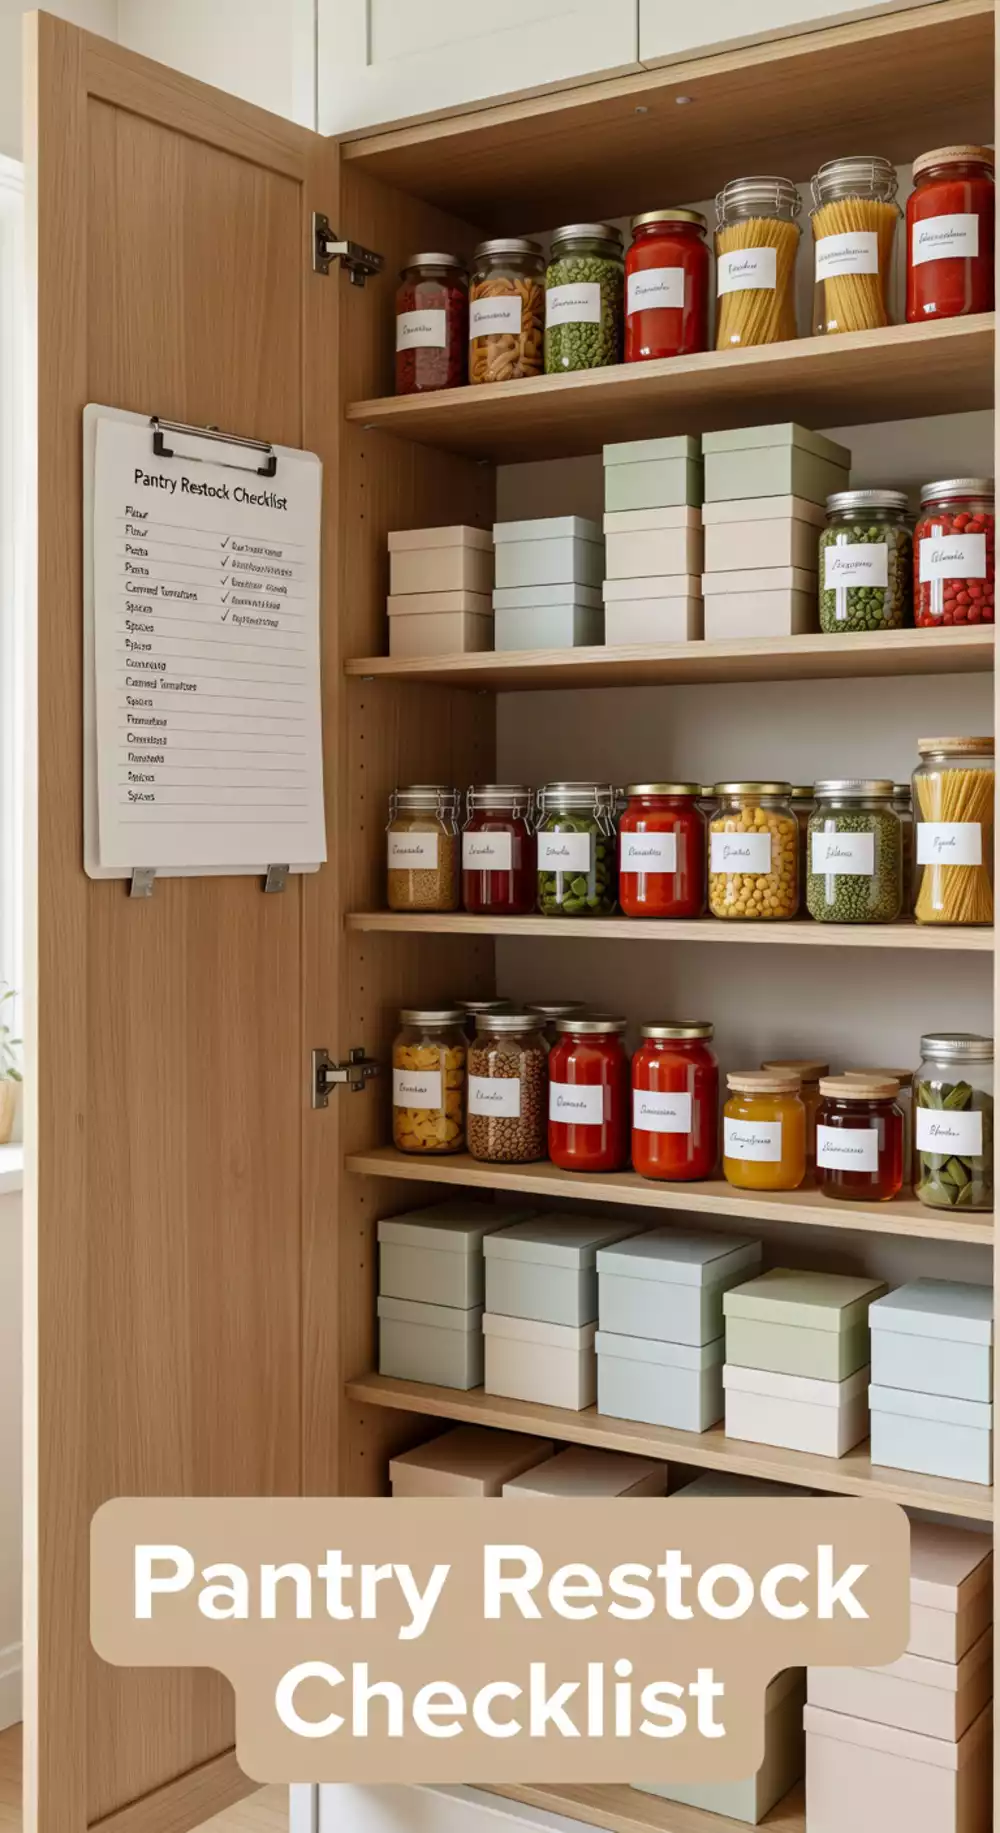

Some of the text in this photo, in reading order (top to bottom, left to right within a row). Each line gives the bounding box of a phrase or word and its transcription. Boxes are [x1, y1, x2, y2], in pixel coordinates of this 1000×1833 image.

[134, 468, 288, 511] Pantry Restock Checklist
